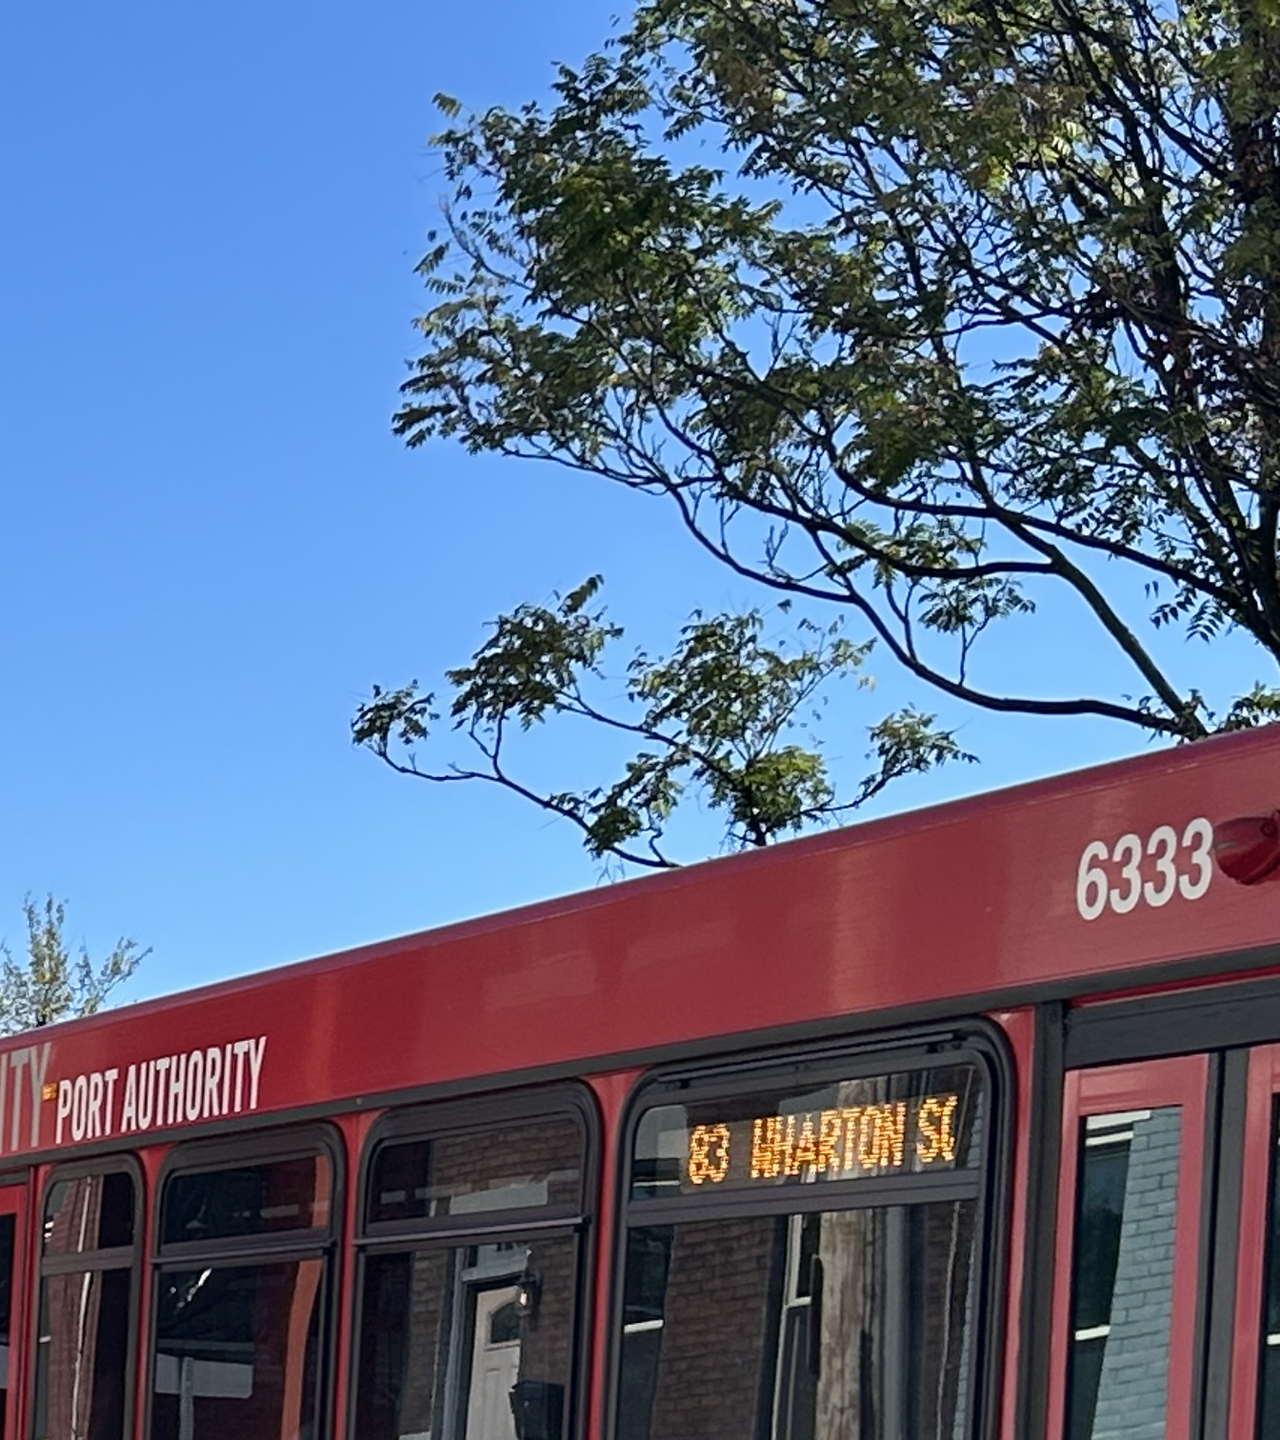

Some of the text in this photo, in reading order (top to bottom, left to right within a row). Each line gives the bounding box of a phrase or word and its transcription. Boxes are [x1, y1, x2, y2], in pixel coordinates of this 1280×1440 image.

[1076, 817, 1214, 921] 6333
[55, 1035, 268, 1145] PORT AUTHORITY
[690, 1122, 731, 1186] 83
[750, 1101, 906, 1179] WHARTON
